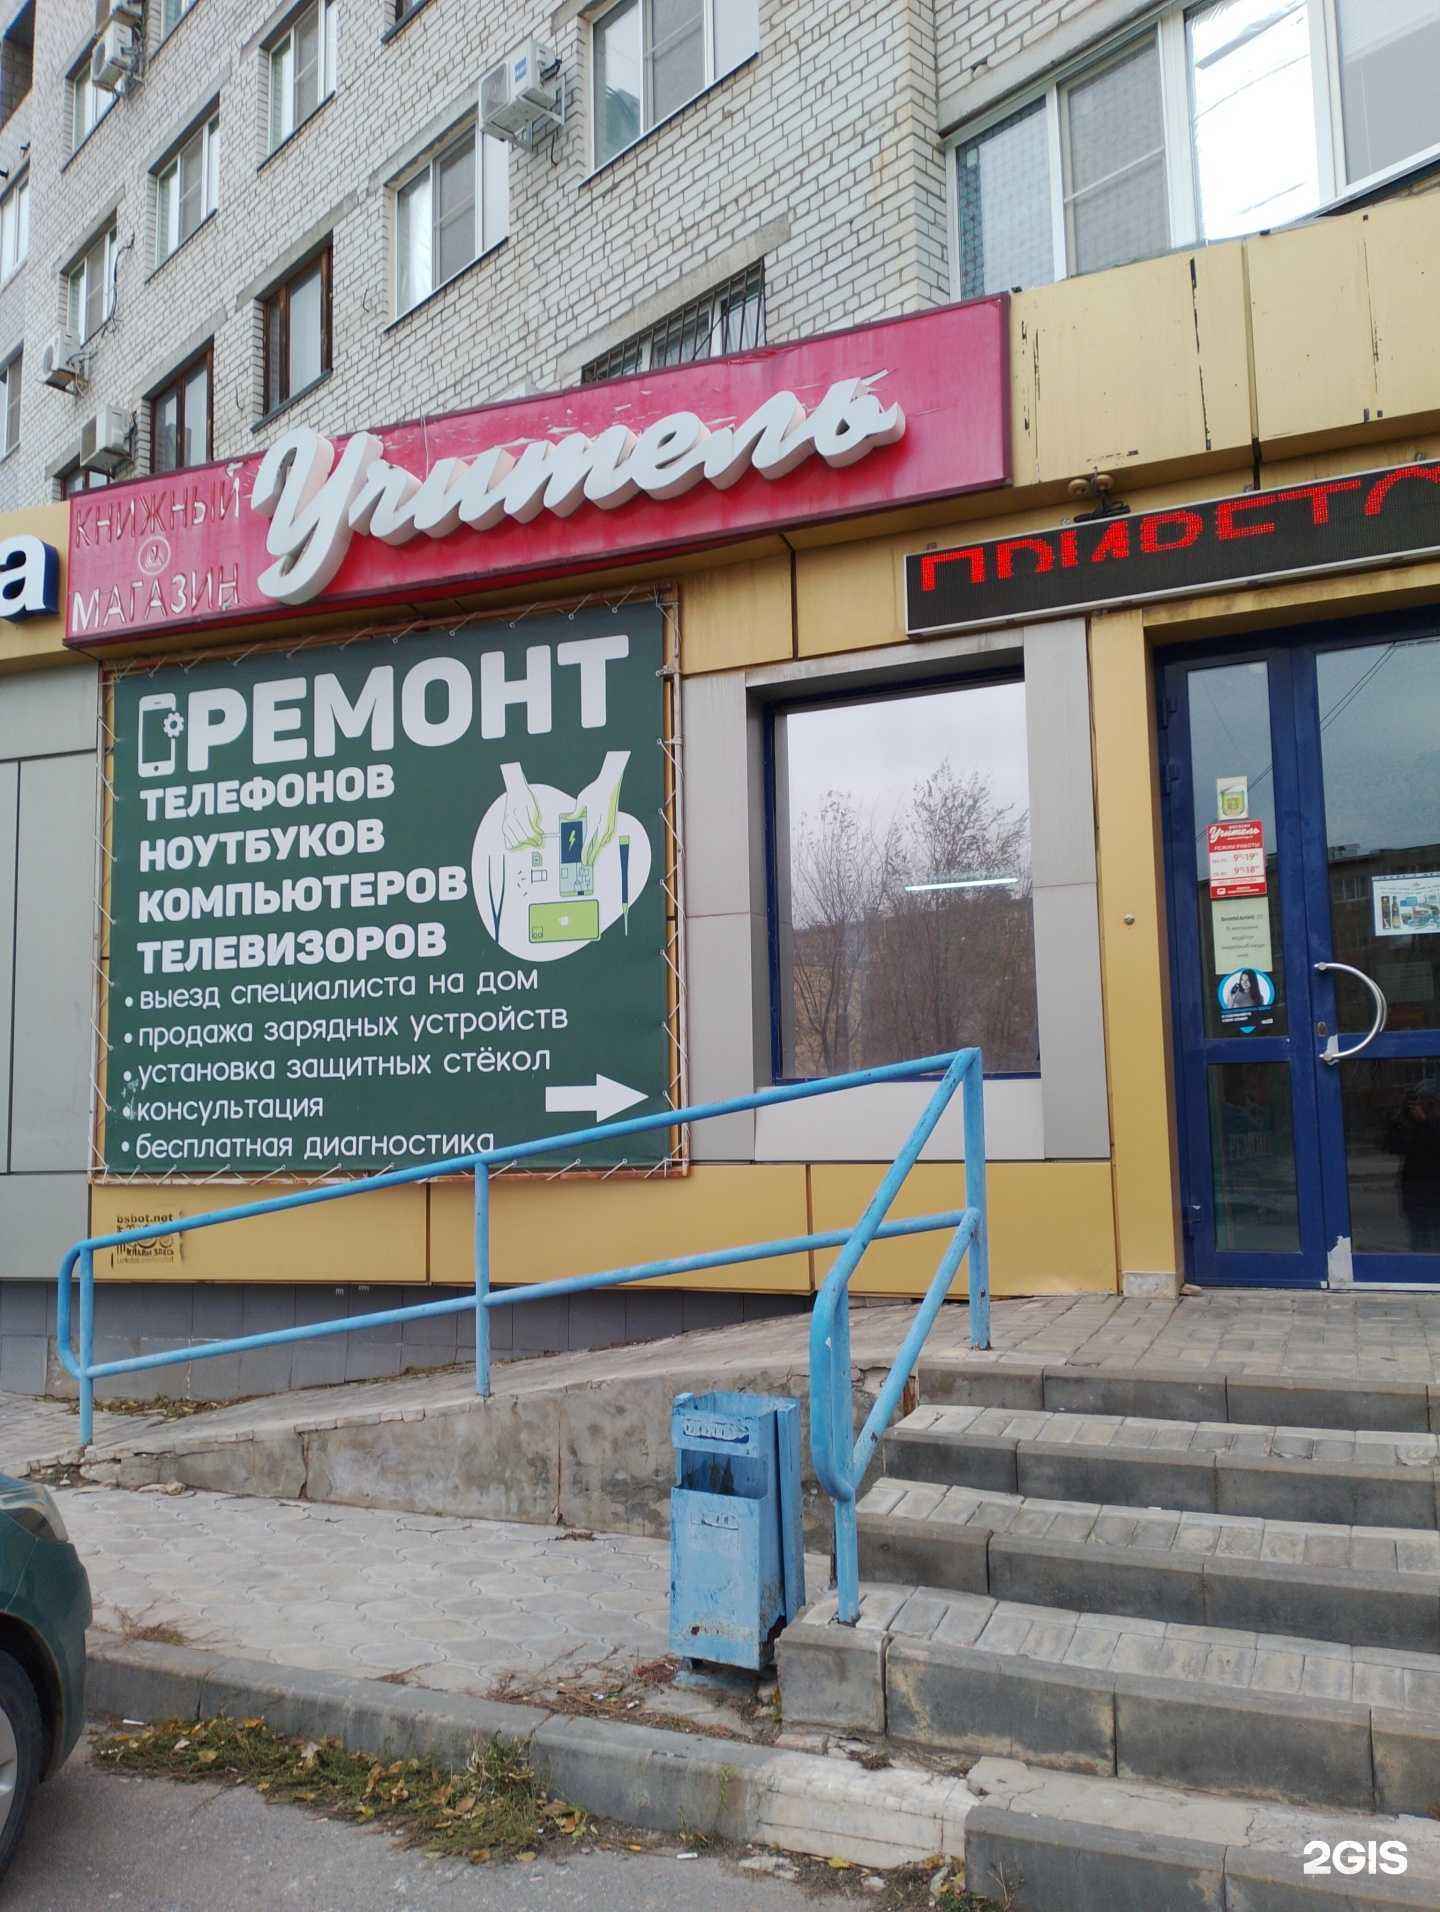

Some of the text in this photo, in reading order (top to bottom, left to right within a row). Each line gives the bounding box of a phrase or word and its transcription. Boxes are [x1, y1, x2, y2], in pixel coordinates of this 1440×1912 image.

[75, 461, 243, 549] КНИЖНЫЙ
[251, 370, 905, 606] Учитель
[71, 563, 241, 633] МАГАЗИН
[188, 635, 630, 772] РЕМОНТ
[140, 764, 395, 822] ТЕЛЕФОНОВ
[139, 819, 385, 873] НОУТБУКОВ
[138, 866, 468, 924] КОМПЬЮТЕРОВ
[137, 922, 447, 975] ТЕЛЕВИЗОРОВ
[140, 965, 539, 1010] выезд специалиста на дом
[139, 1005, 569, 1053] продажа зарядных устройств
[138, 1047, 550, 1091] установка защитных стёкол
[137, 1098, 324, 1127] консультация
[136, 1133, 495, 1162] бесплатная диагностика
